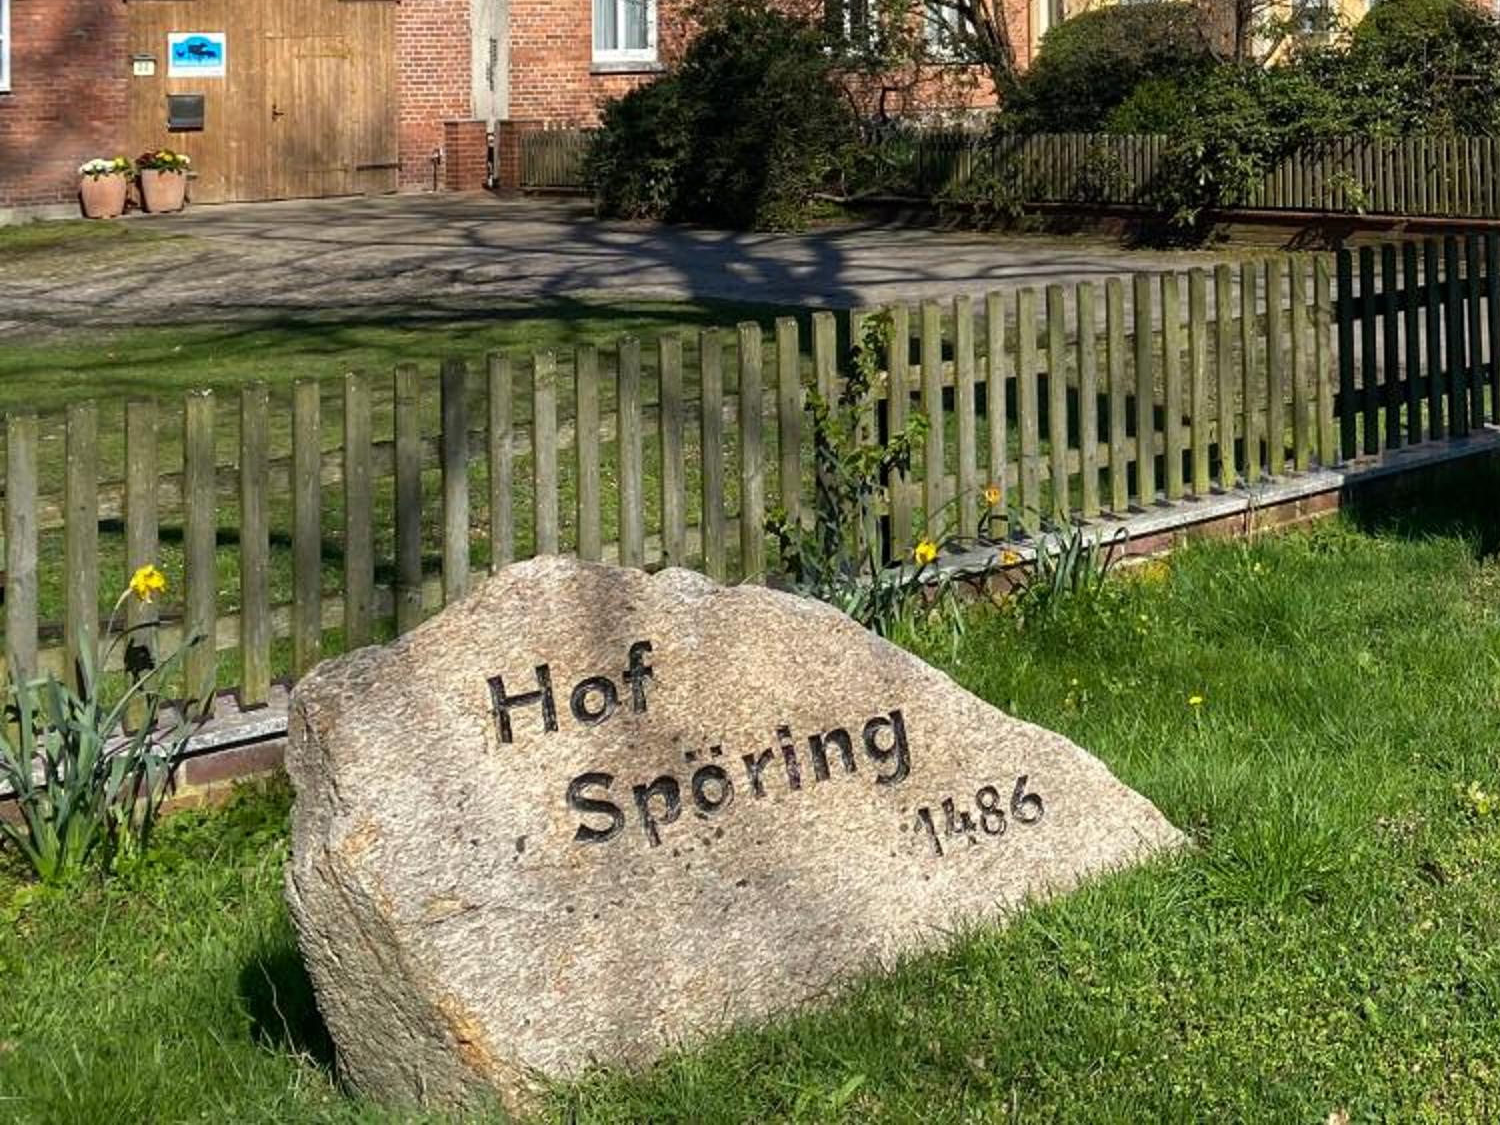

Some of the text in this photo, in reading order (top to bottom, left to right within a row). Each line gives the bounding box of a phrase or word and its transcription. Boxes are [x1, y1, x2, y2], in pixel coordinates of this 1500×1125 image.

[486, 639, 654, 744] Hof
[565, 707, 912, 847] Spöring
[914, 775, 1045, 857] 1486
